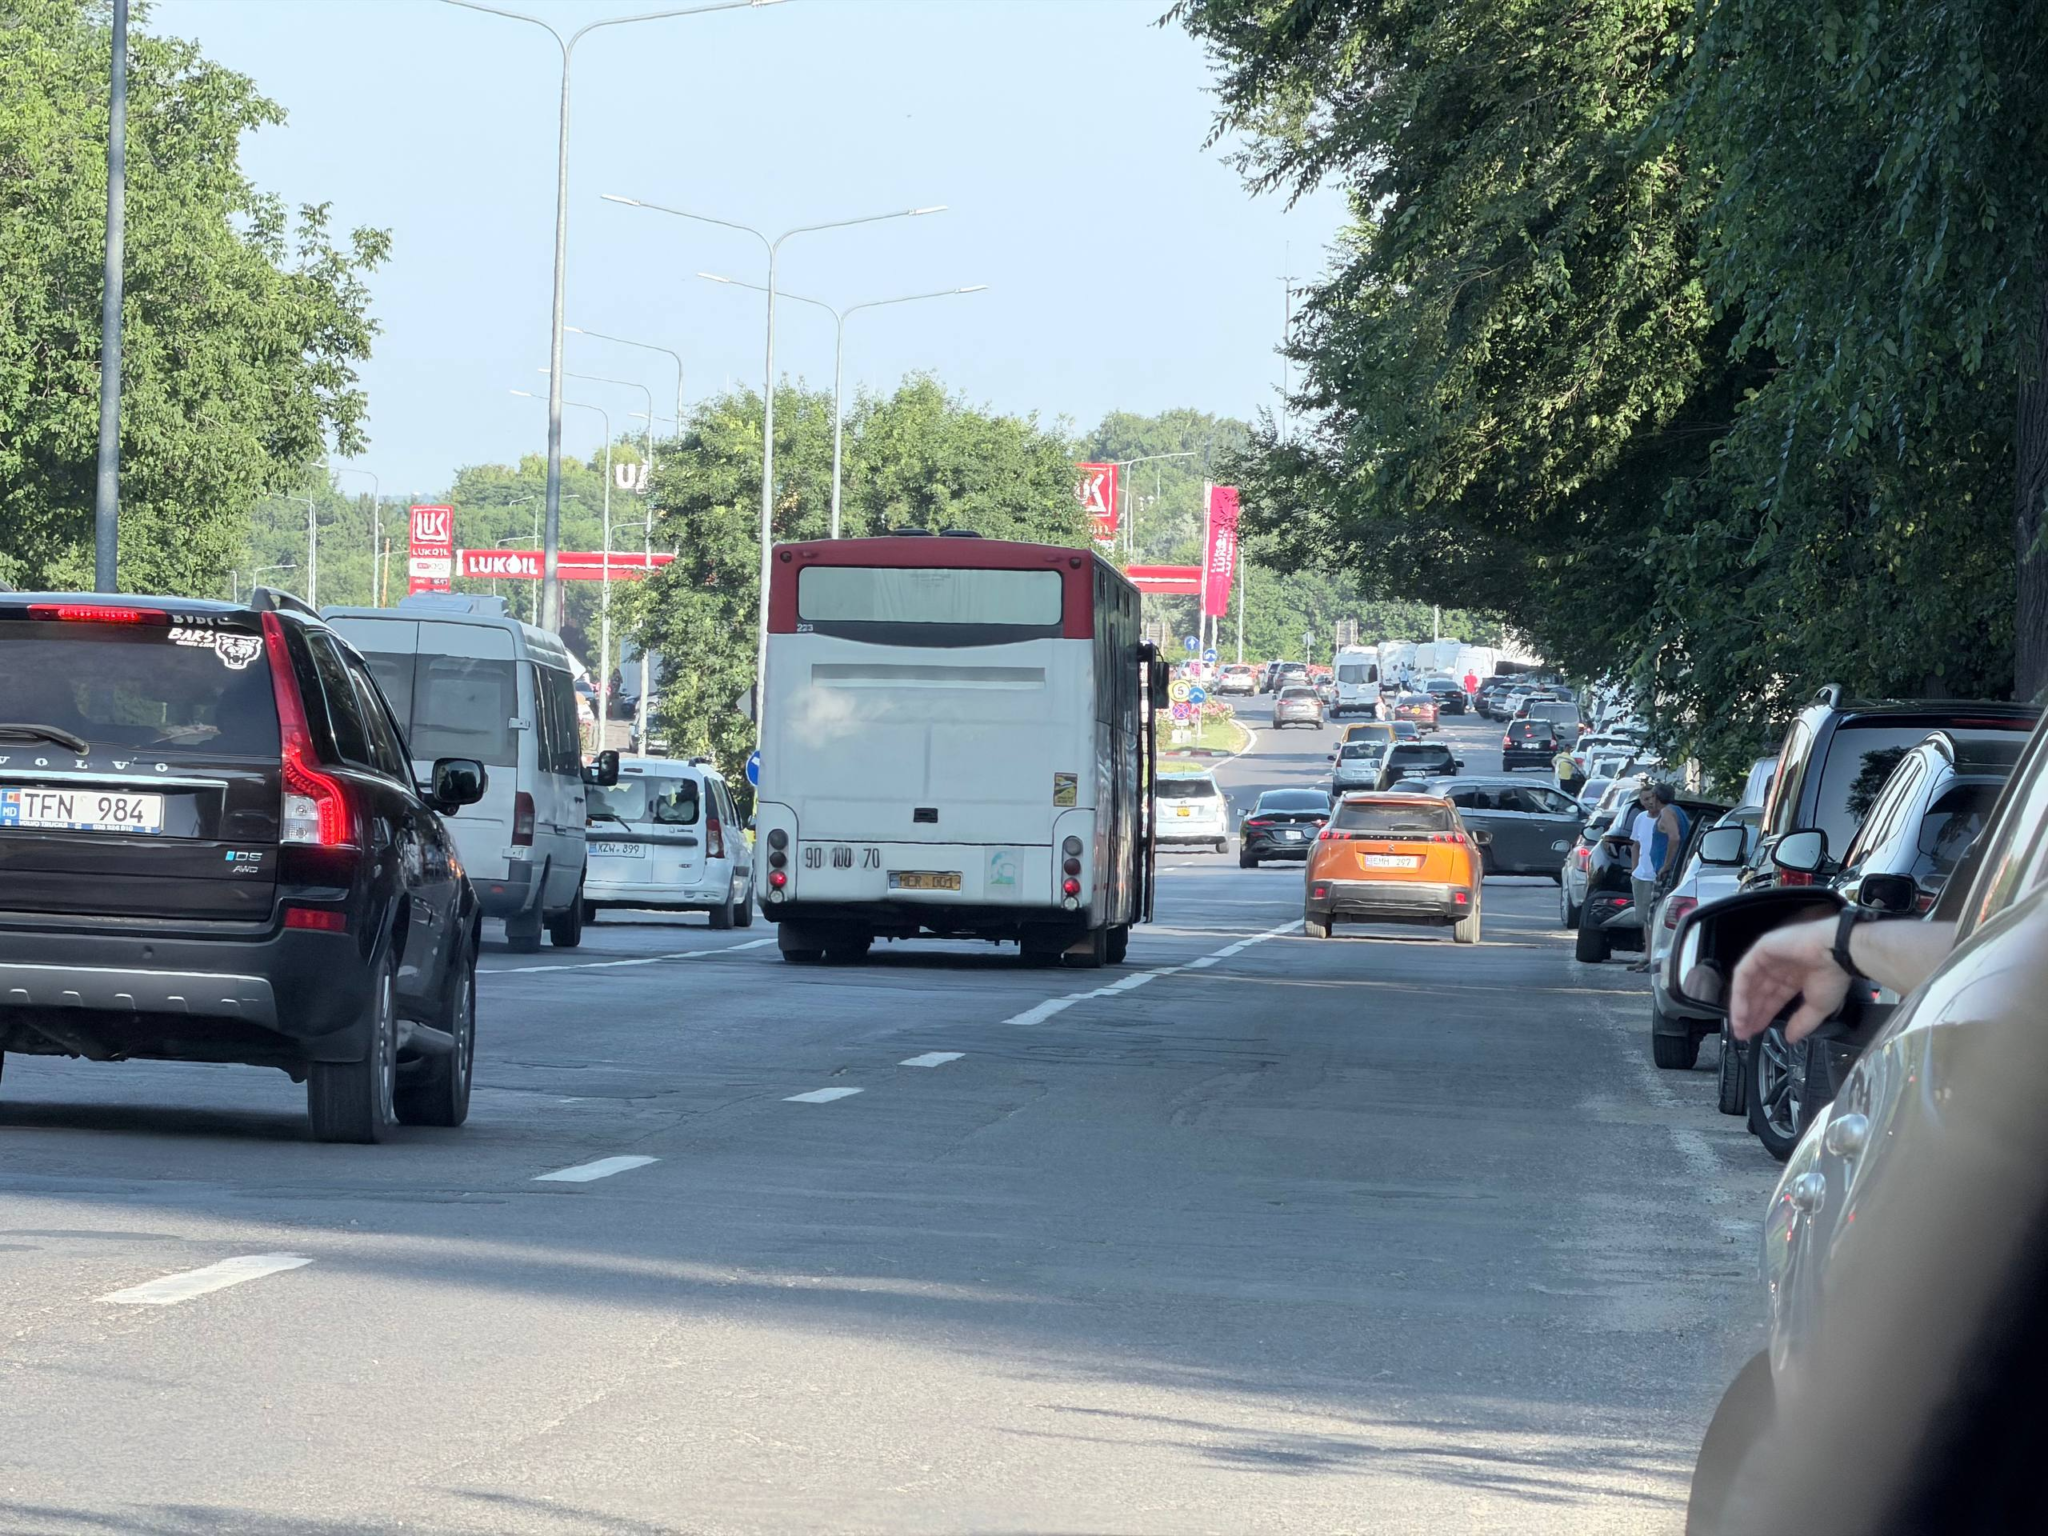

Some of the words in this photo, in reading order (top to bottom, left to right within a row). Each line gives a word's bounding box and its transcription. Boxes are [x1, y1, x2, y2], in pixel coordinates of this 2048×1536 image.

[412, 547, 450, 556] LUKOIL
[469, 554, 539, 575] LUKOIL
[168, 628, 214, 643] BARS
[0, 755, 168, 773] VOLVO
[3, 806, 17, 817] MD
[25, 792, 74, 820] TFN
[97, 796, 144, 824] 984
[804, 847, 822, 869] 90
[832, 847, 852, 869] 100
[863, 848, 881, 869] 70
[232, 865, 259, 873] AWD
